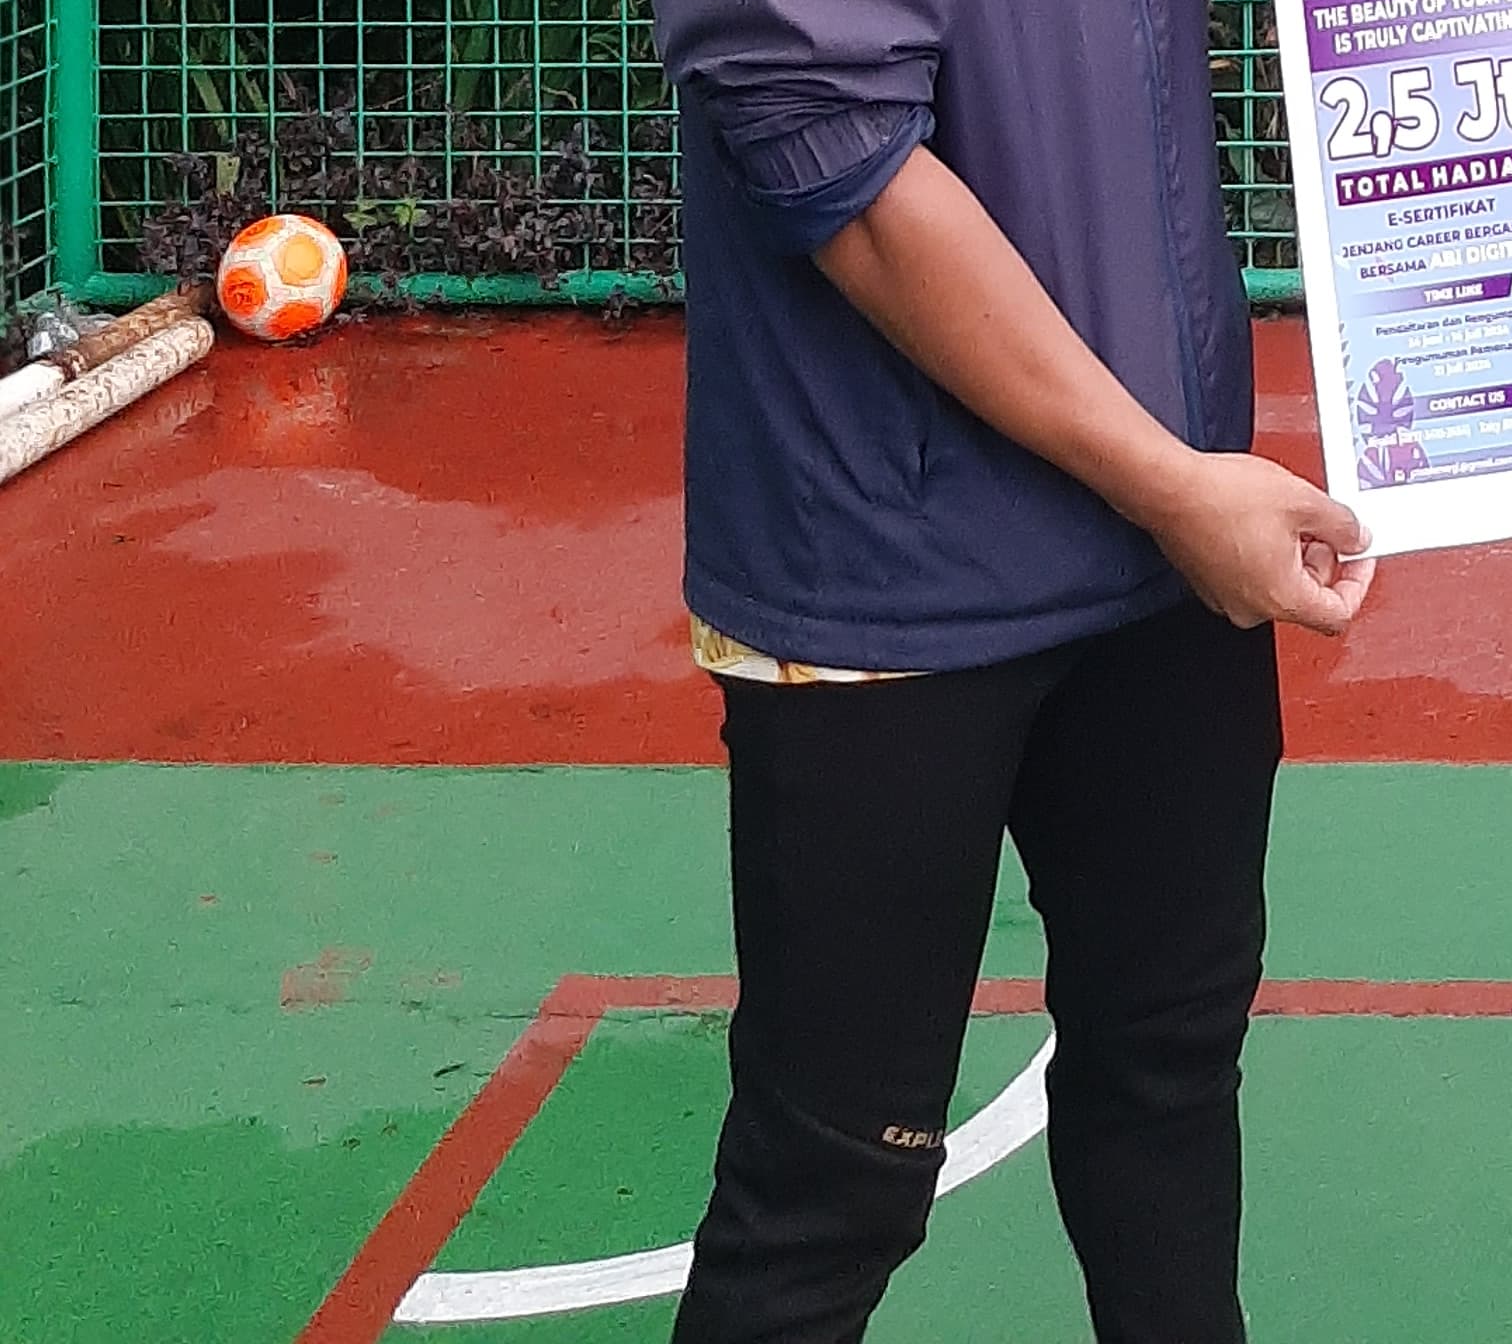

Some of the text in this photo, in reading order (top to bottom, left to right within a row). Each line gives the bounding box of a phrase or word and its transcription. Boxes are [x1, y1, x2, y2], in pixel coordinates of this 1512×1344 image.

[1313, 7, 1349, 29] THE
[1334, 35, 1352, 54] IS
[1353, 27, 1408, 51] TRULY
[1320, 66, 1440, 161] 2,5
[1340, 169, 1425, 200] TOTAL
[1388, 198, 1496, 226] E-SERTIFIKAT
[1342, 238, 1403, 258] JENJANG
[1406, 229, 1460, 249] CAREER
[1360, 259, 1427, 279] BERSAMA
[1429, 390, 1506, 412] CONTACT US
